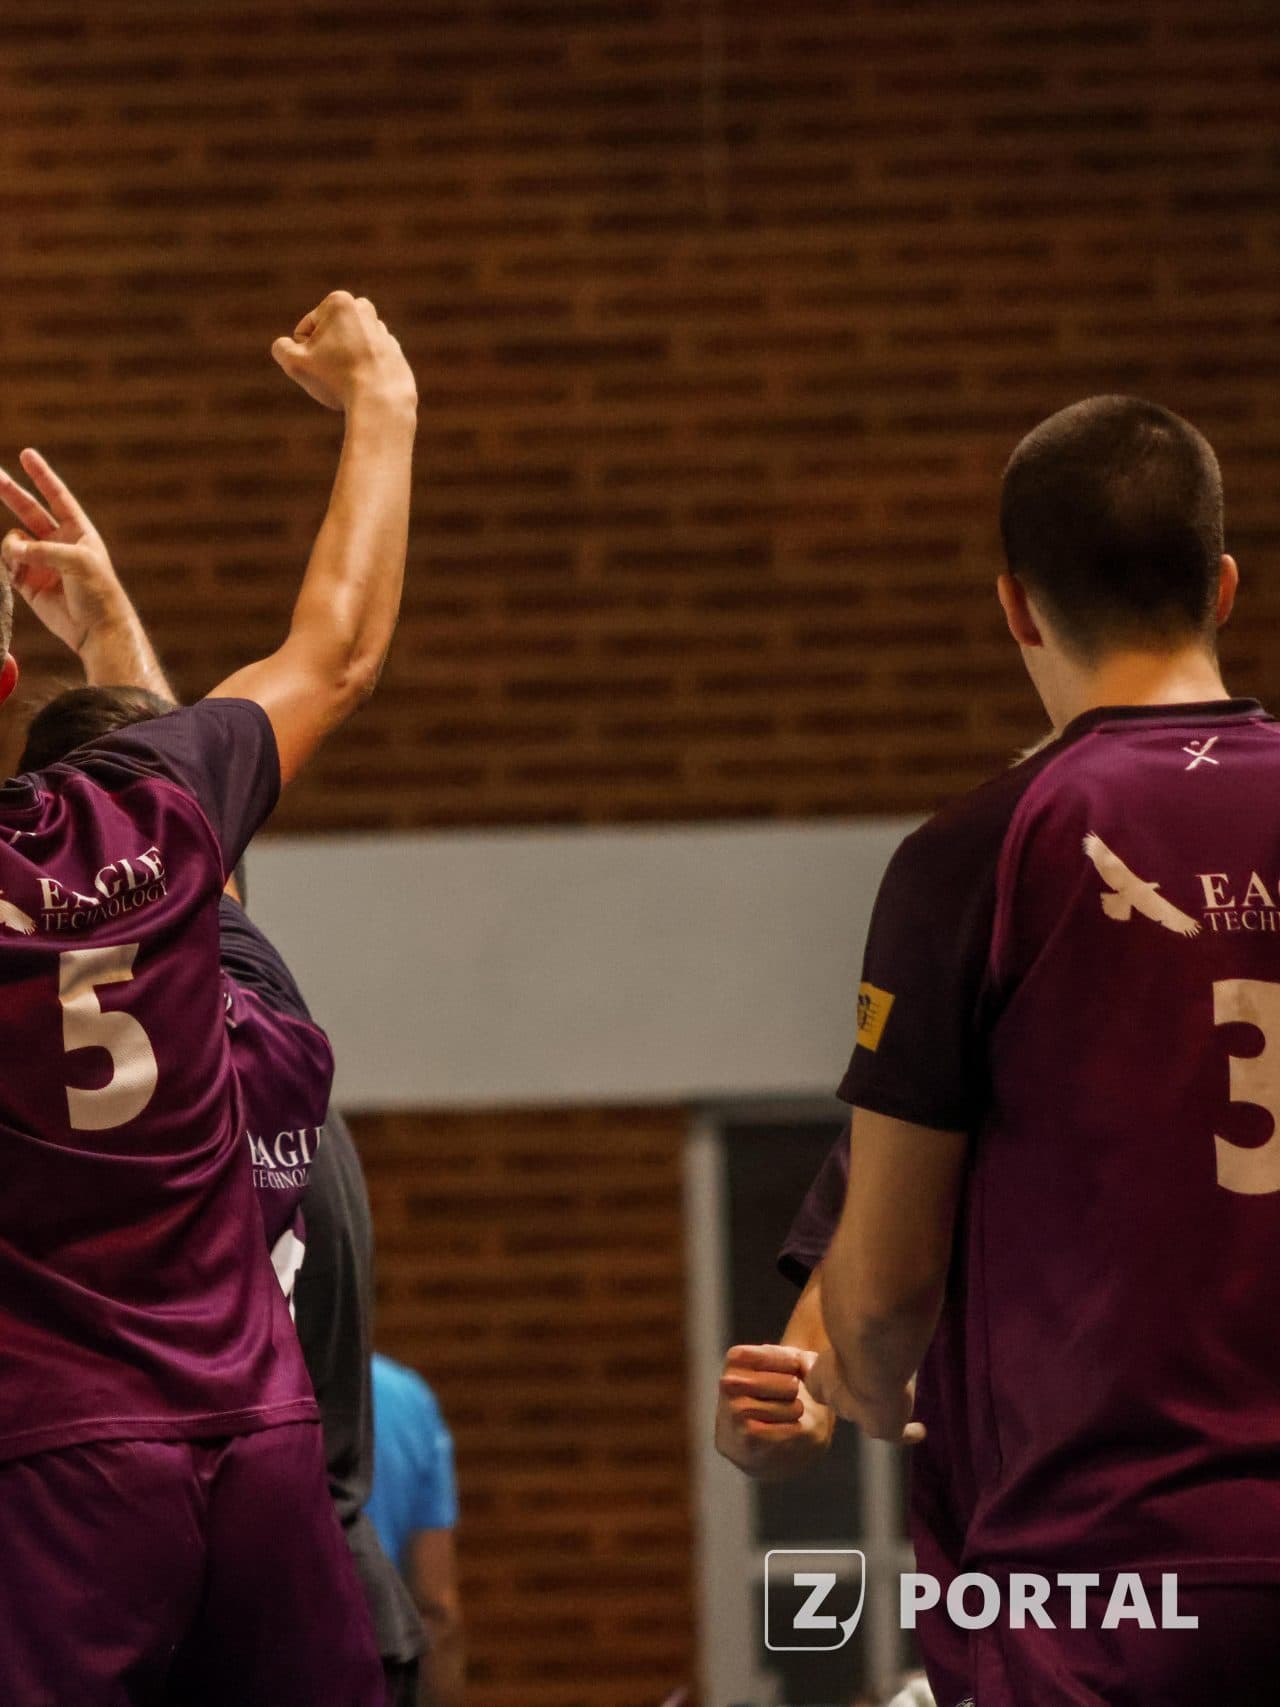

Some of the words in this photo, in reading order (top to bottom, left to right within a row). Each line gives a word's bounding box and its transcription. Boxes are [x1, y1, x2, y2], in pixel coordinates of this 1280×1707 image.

[1195, 871, 1280, 908] EA
[1204, 909, 1280, 931] TECH
[59, 943, 158, 1131] 5
[1212, 979, 1280, 1195] 3
